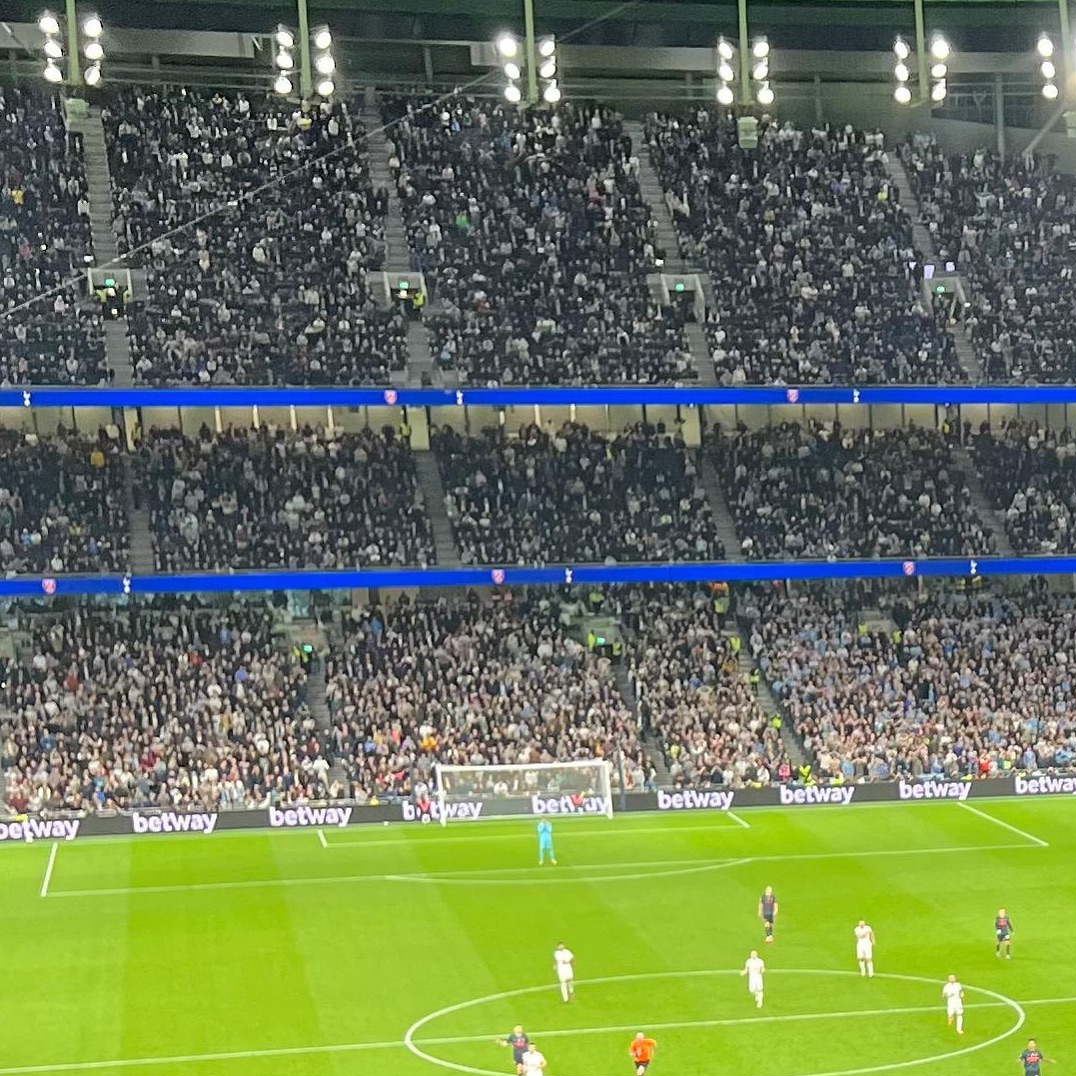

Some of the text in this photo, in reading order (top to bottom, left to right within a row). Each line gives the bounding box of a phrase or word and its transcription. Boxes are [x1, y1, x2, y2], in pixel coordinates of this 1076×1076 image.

[658, 789, 734, 810] betway
[780, 784, 855, 804] betway
[900, 779, 972, 800] betway
[133, 812, 217, 834] betway
[269, 806, 351, 827] betway
